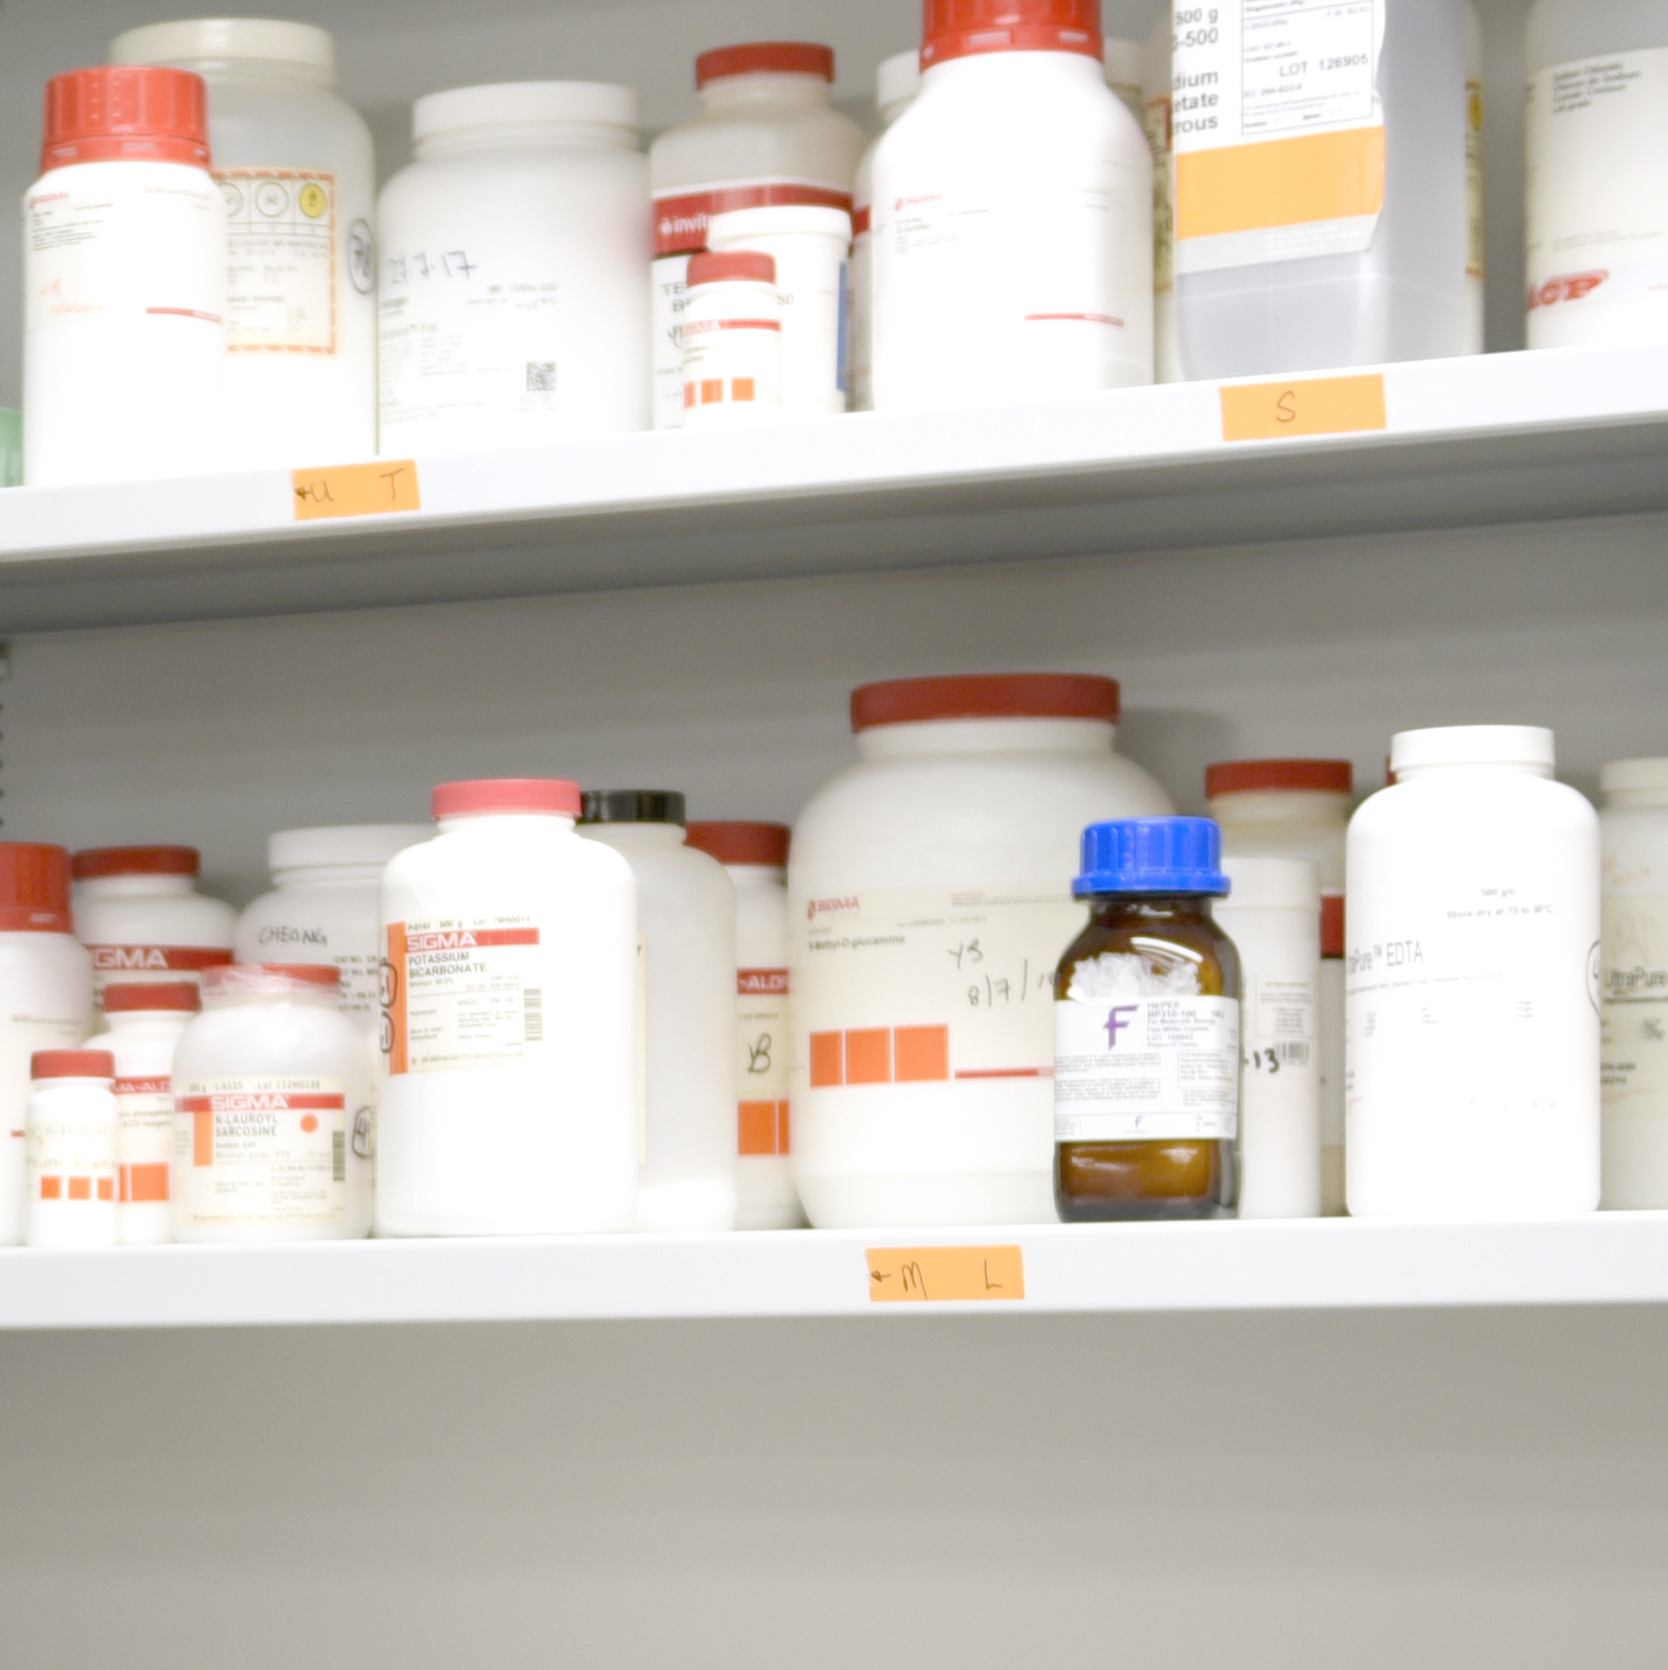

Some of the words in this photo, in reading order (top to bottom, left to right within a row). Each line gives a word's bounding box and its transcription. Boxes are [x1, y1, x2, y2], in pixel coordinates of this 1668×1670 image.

[1175, 8, 1202, 26] 500
[1208, 7, 1219, 24] g
[1279, 61, 1309, 77] LOT
[1318, 53, 1370, 71] 126905
[1274, 390, 1297, 424] S
[378, 467, 406, 501] T
[815, 896, 861, 913] SIGMA
[406, 930, 478, 951] SIGMA
[408, 950, 470, 967] POTASSIUM
[1386, 939, 1425, 967] EDTA
[408, 962, 488, 980] BICARBONATE
[210, 1093, 290, 1111] SIGMA
[215, 1112, 279, 1126] N-LAUROYL
[215, 1125, 278, 1138] SARCOSINE
[984, 1258, 1004, 1291] L
